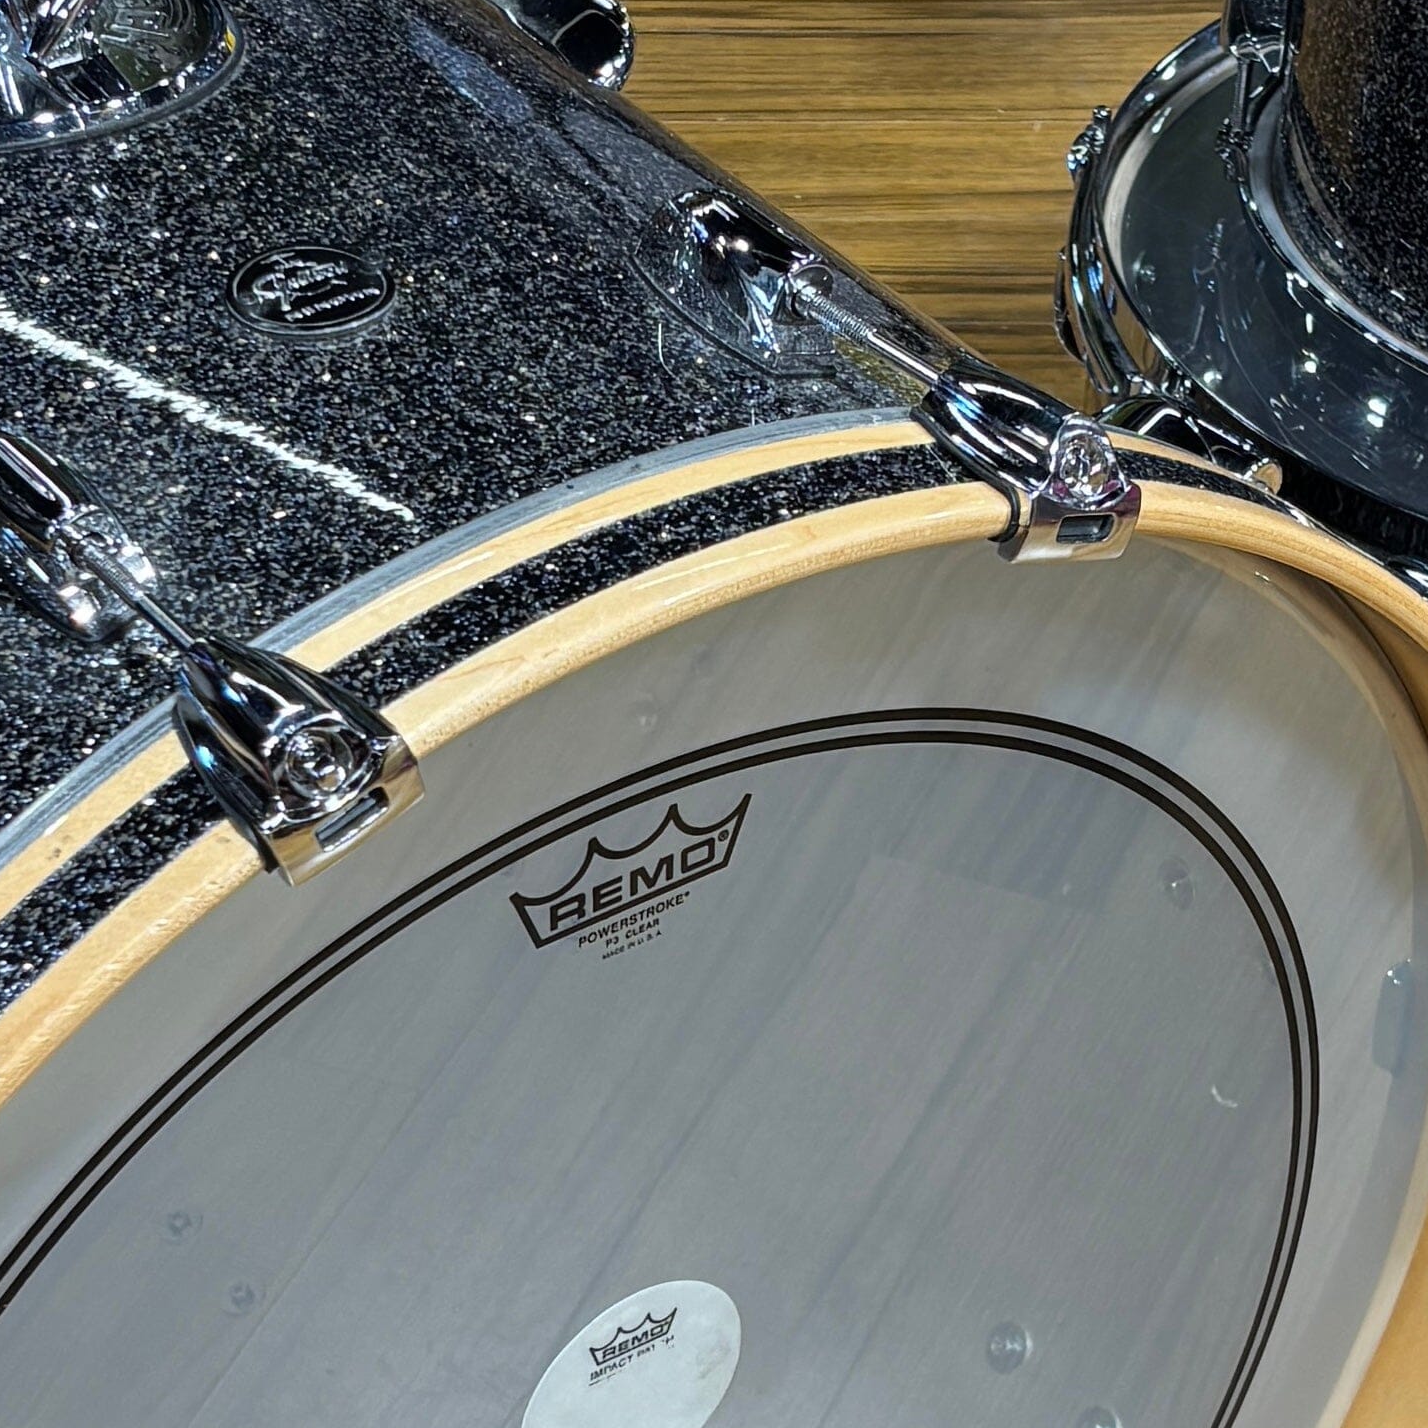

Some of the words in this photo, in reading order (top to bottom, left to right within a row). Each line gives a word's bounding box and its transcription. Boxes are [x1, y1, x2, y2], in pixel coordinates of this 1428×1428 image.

[549, 836, 716, 932] REMO
[578, 894, 684, 948] POWERSTROKE
[625, 918, 660, 939] CLEAR
[602, 1324, 664, 1360] REMO
